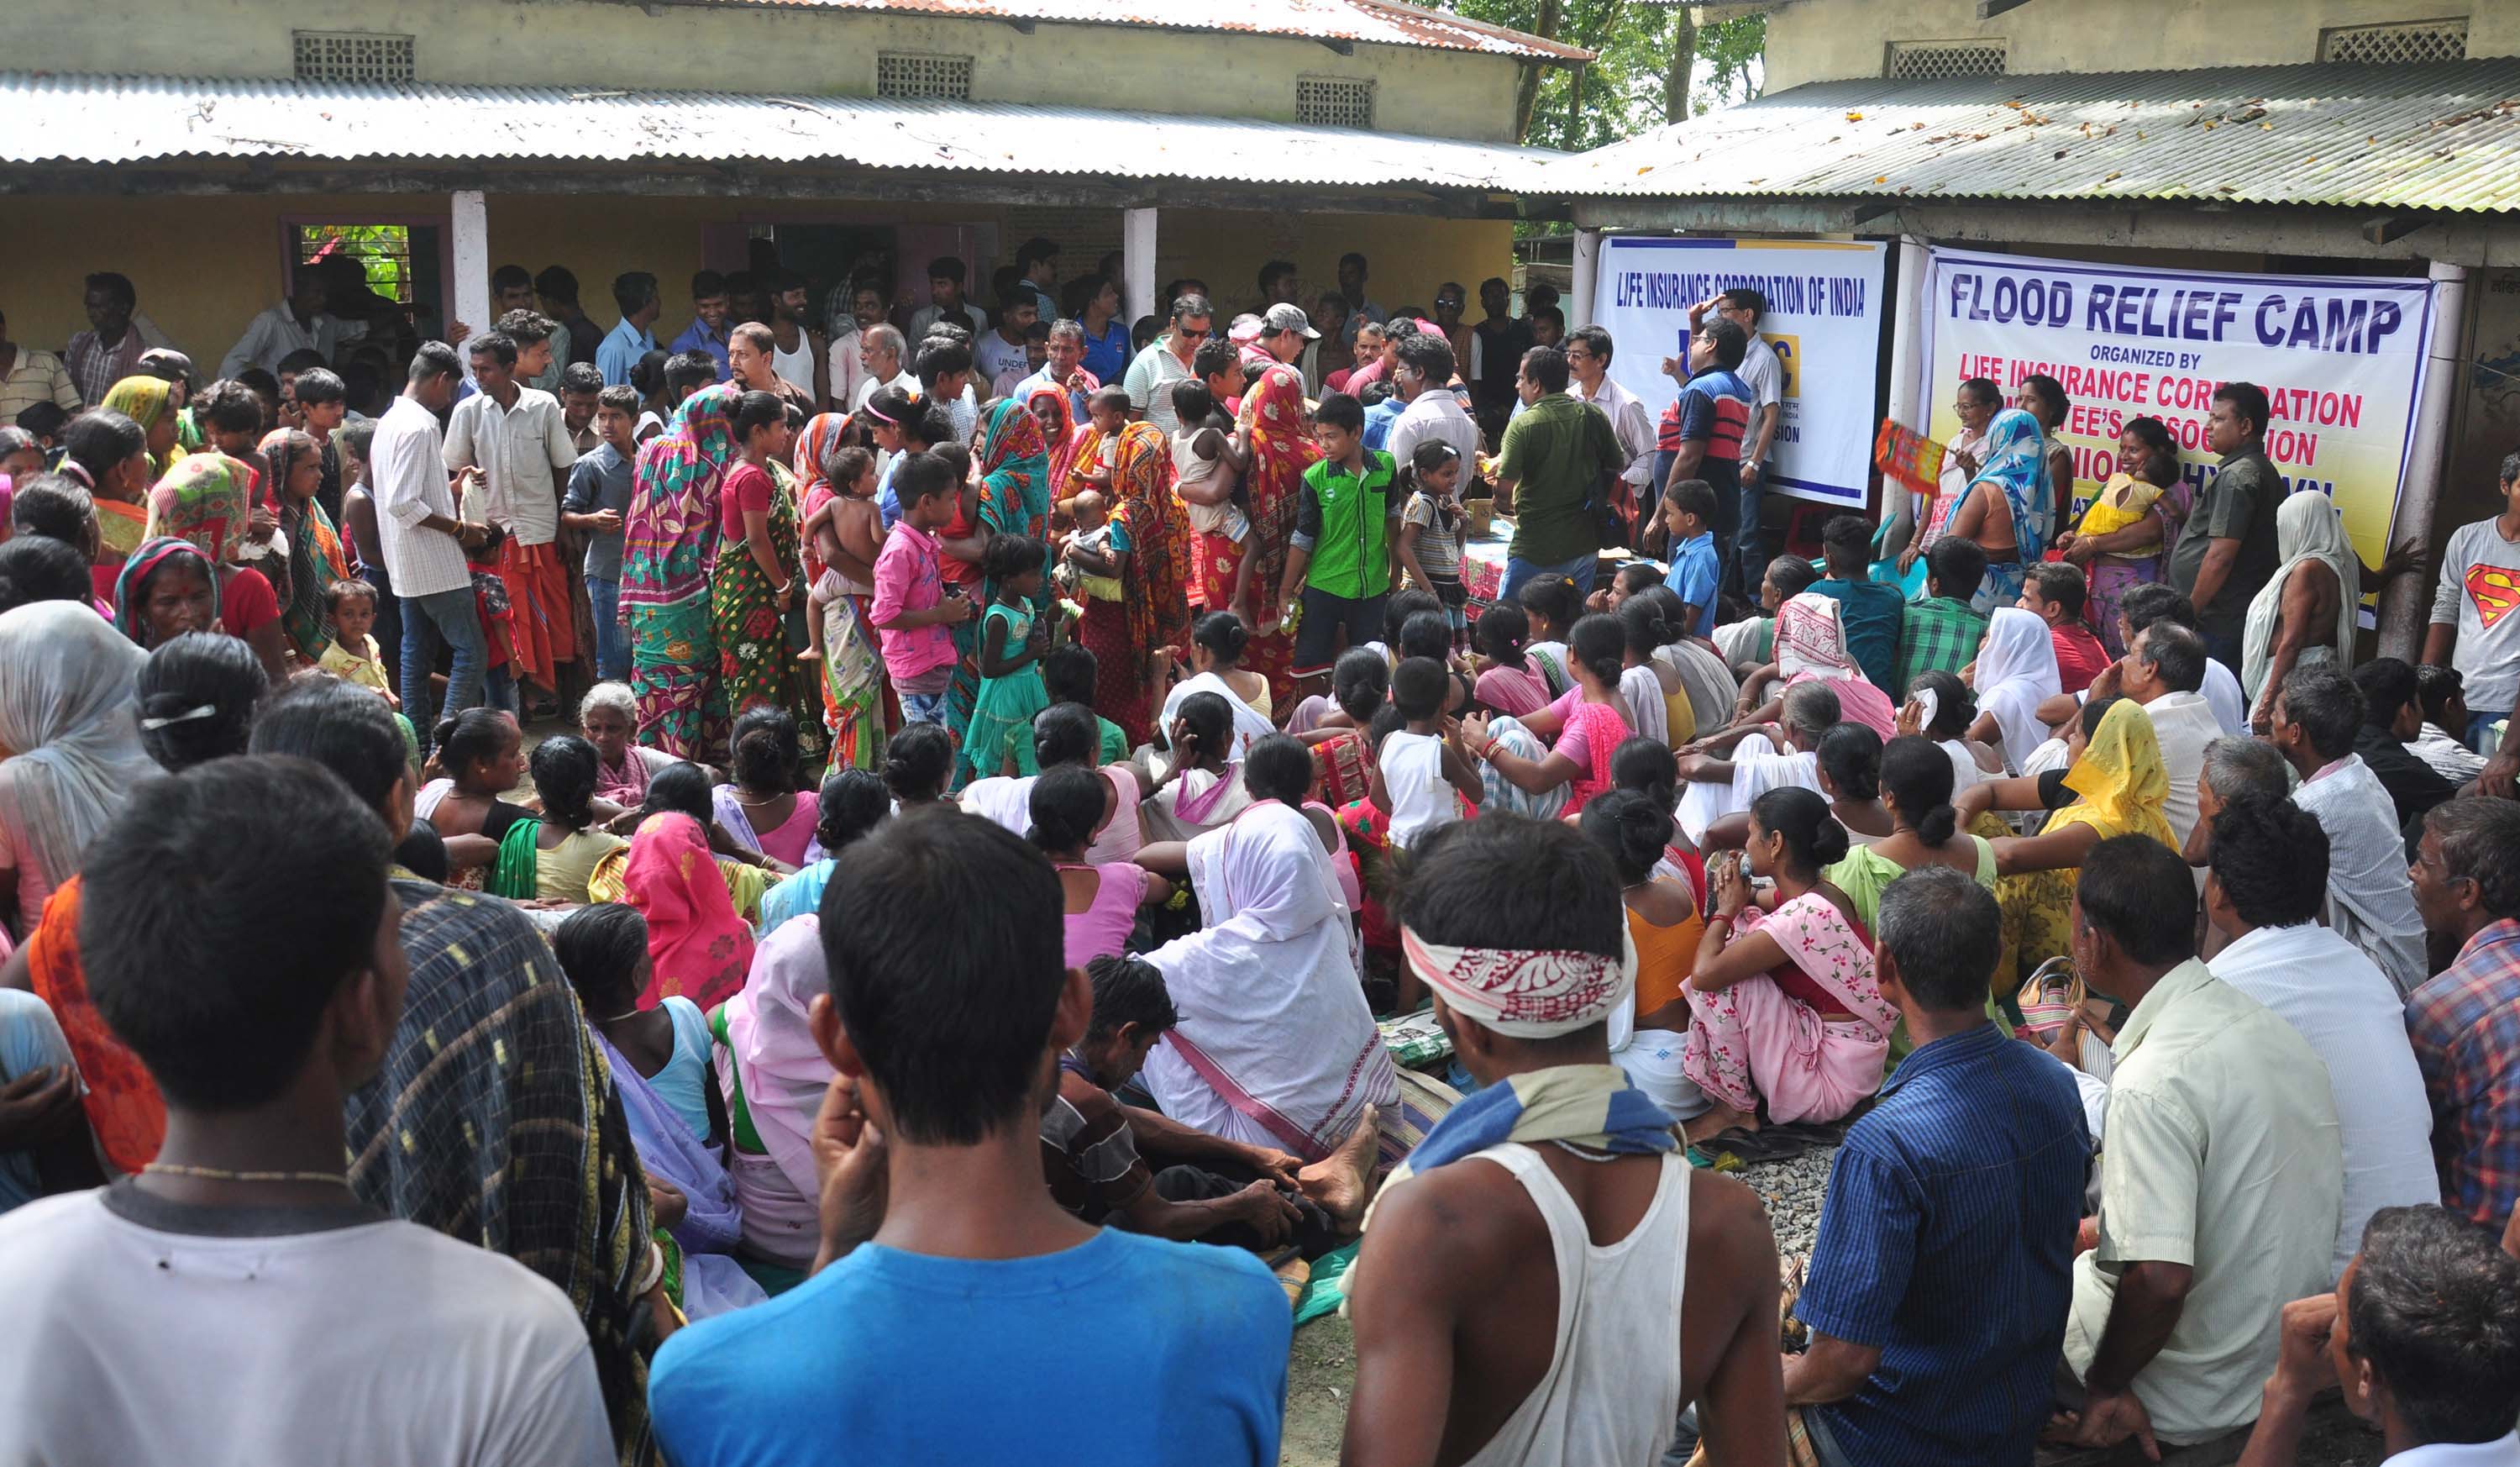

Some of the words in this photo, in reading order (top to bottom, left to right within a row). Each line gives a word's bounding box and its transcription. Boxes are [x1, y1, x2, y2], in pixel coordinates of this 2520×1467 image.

[1617, 272, 1643, 308] LIFE
[1809, 276, 1825, 316] OF
[1830, 277, 1865, 317] INDIA
[1950, 273, 2073, 329] FLOOD
[2086, 284, 2244, 342] RELIEF
[2255, 294, 2402, 355] CAMP
[2090, 344, 2175, 367] ORGANIZED
[2179, 353, 2202, 371] BY
[1958, 353, 2003, 386] LIFE
[2156, 375, 2362, 429] CORATION
